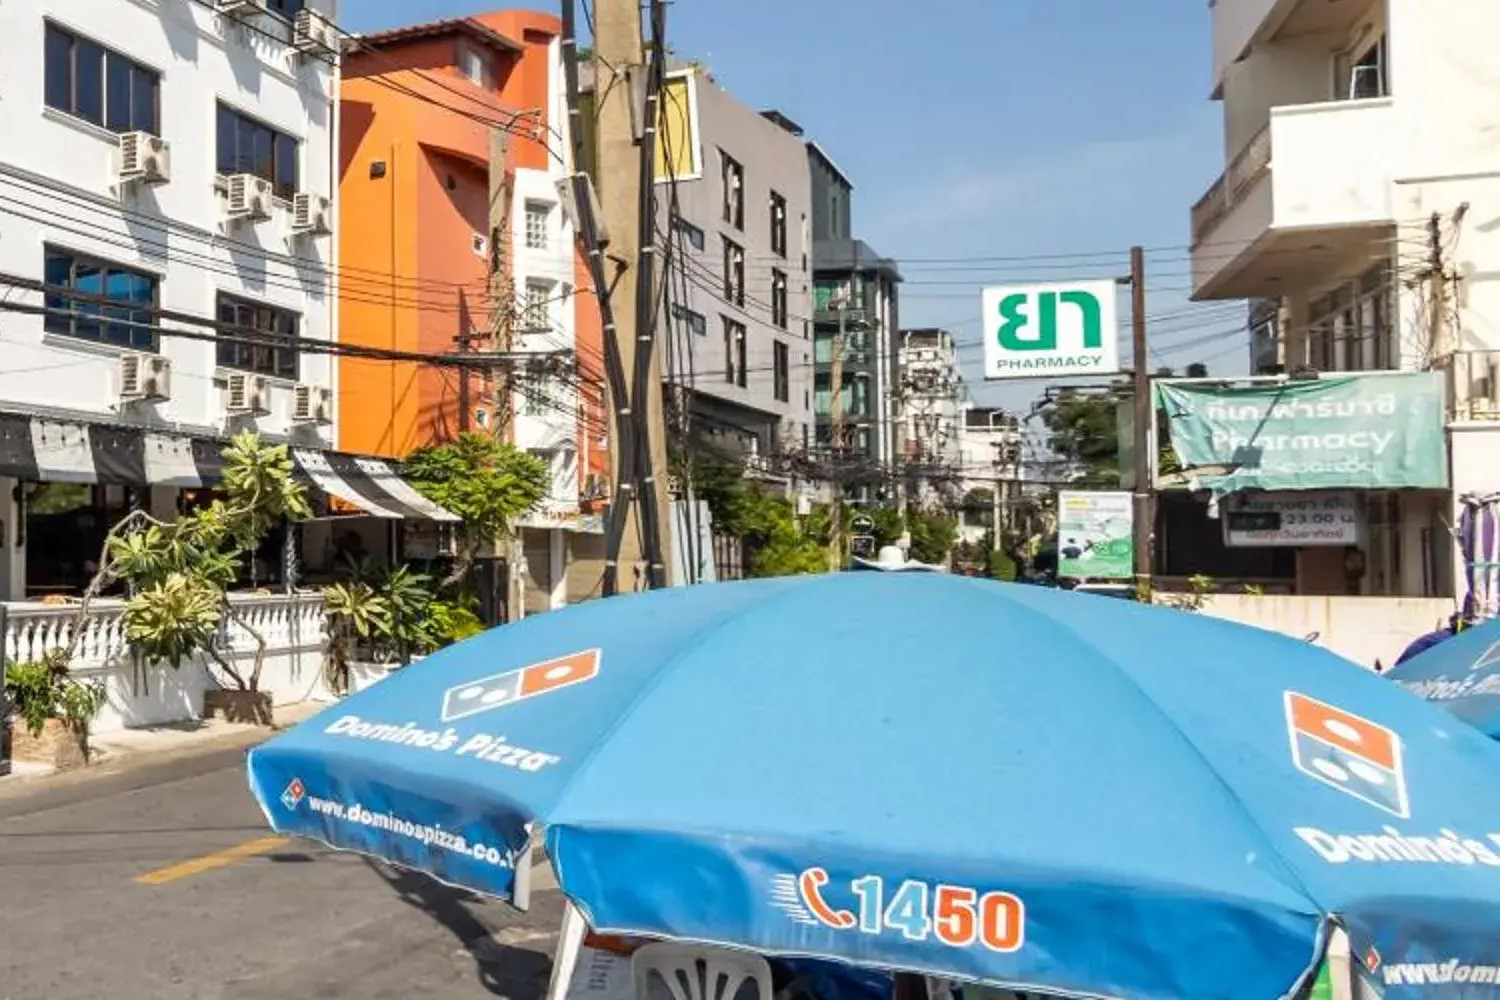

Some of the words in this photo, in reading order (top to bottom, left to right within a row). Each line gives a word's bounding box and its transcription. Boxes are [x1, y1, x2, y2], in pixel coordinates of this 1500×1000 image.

[997, 291, 1102, 351] ยา
[997, 355, 1103, 370] PHARMACY
[1212, 430, 1393, 455] Pharmacy
[324, 715, 459, 751] Domino's
[308, 794, 515, 870] www.dominospizza.co.t
[851, 874, 1026, 953] 1450
